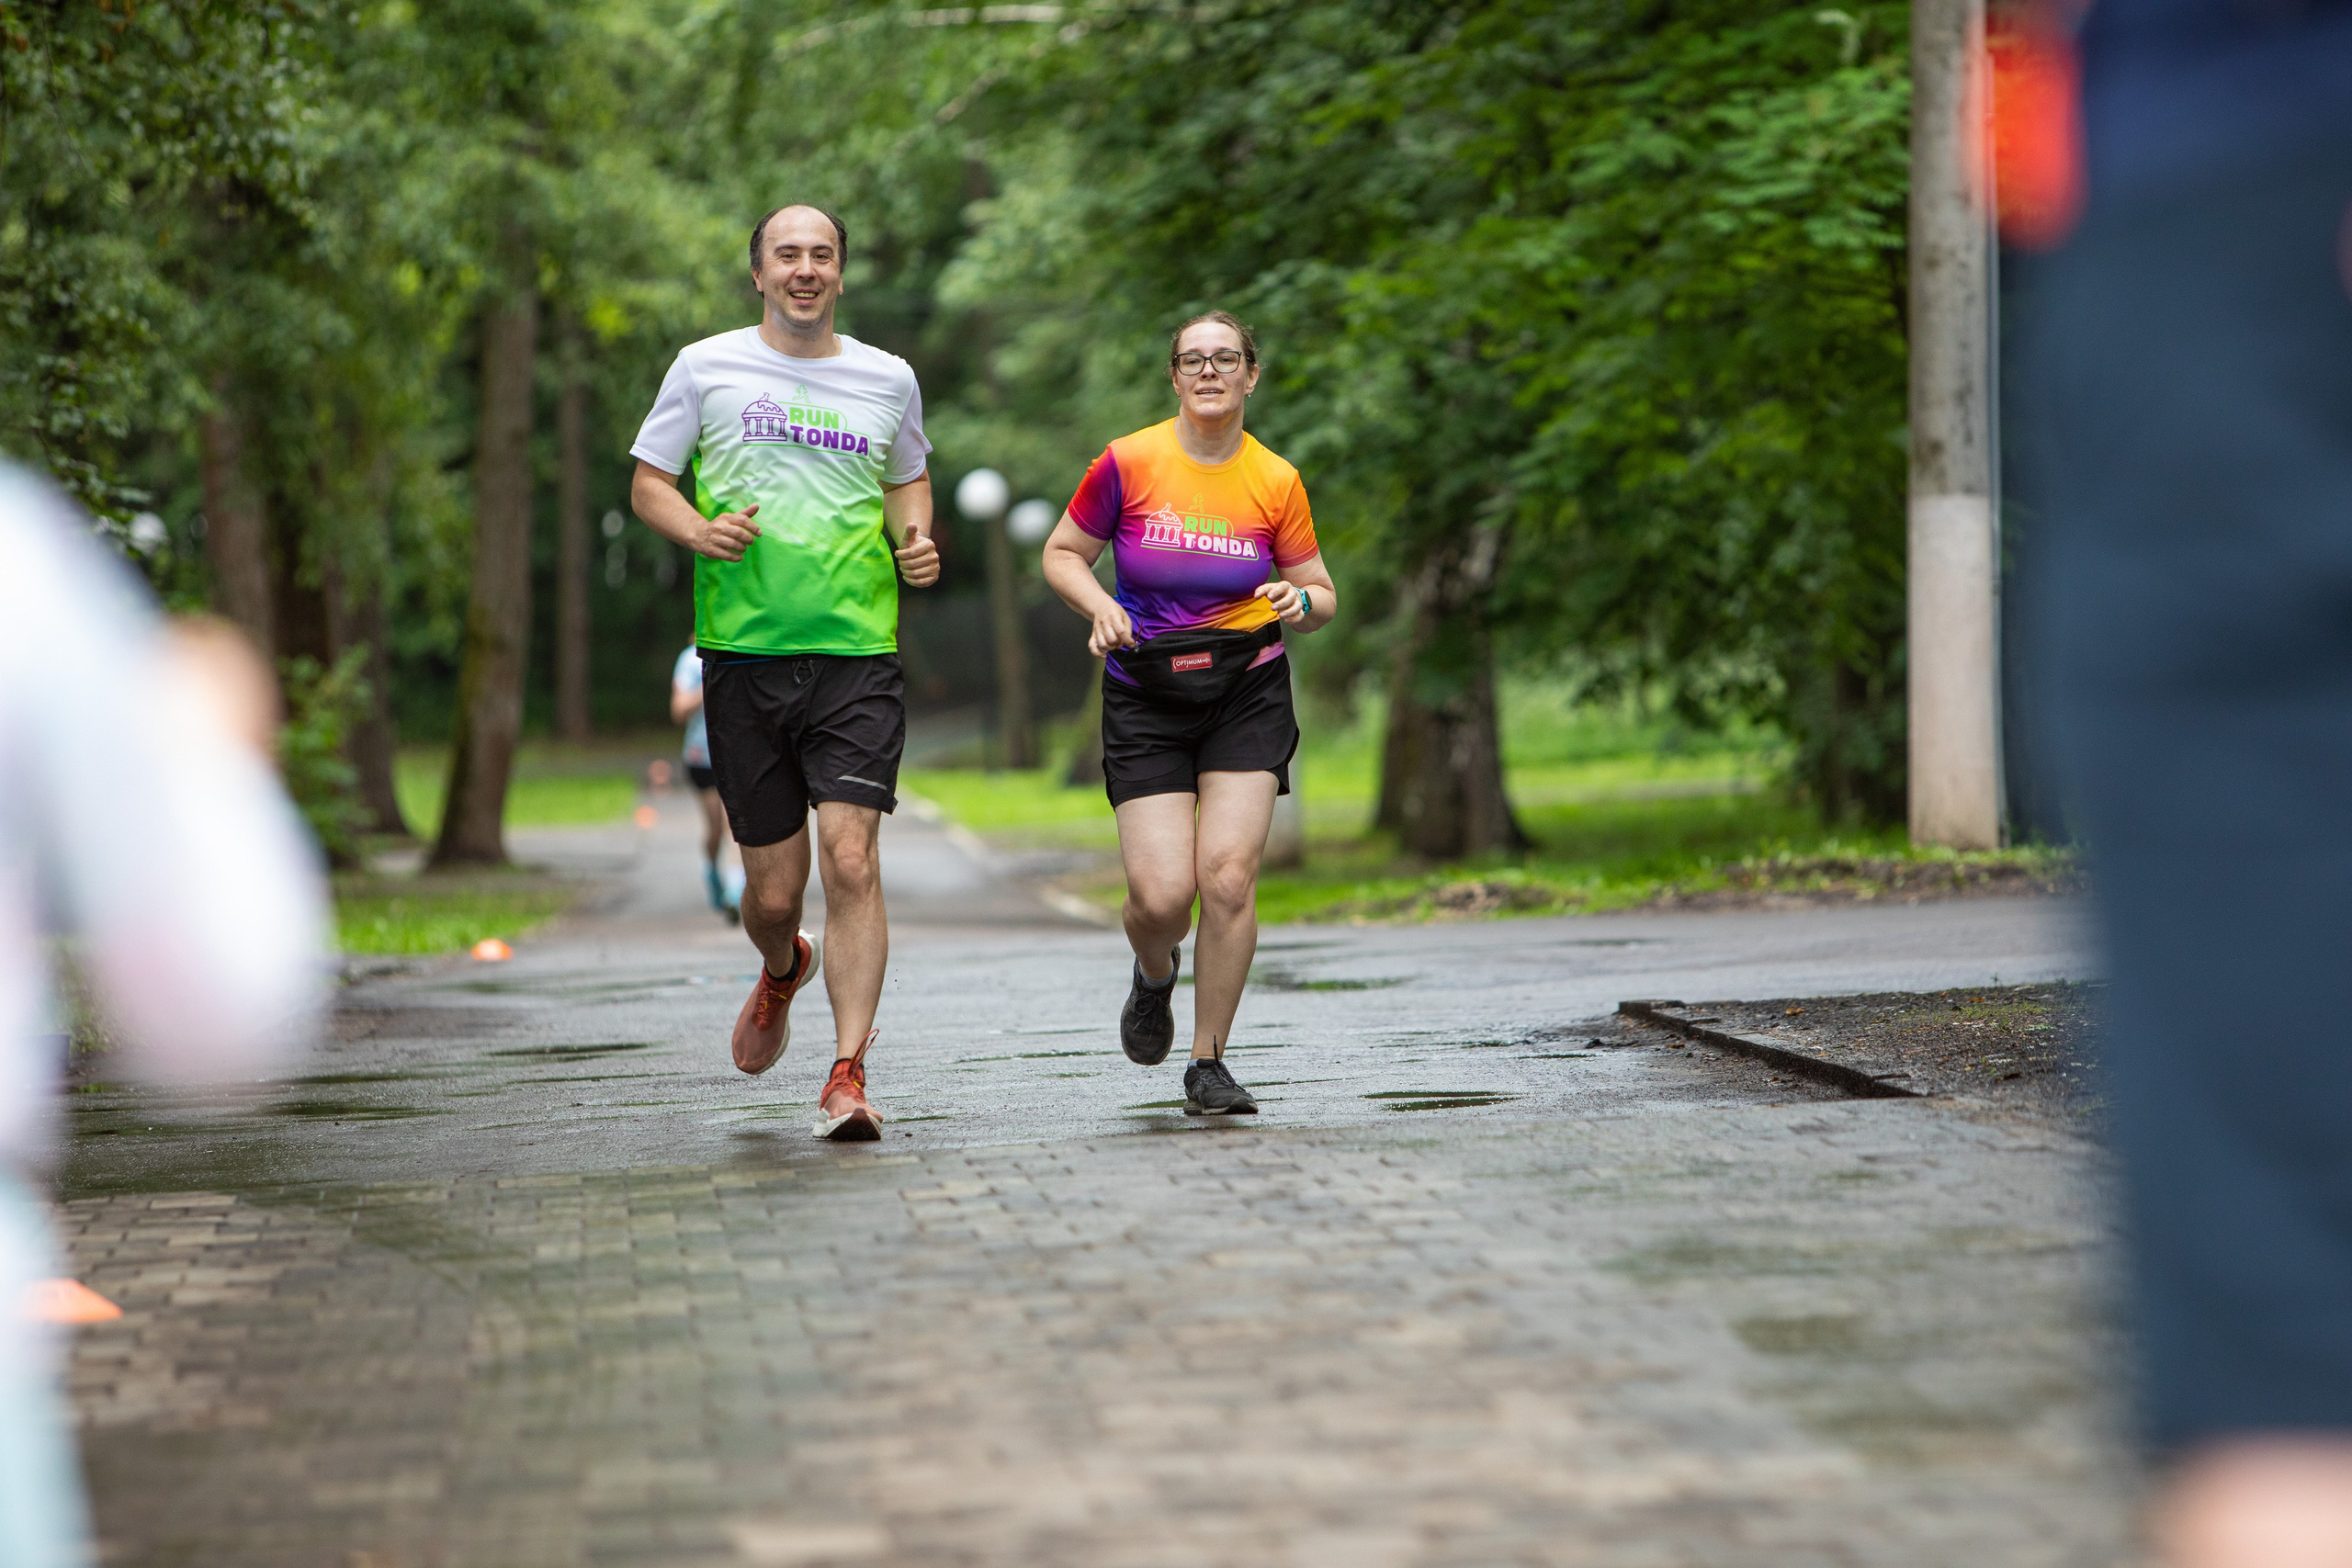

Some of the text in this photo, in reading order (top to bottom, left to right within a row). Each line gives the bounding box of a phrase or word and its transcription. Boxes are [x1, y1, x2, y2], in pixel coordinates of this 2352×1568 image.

[790, 407, 840, 429] RUN
[790, 425, 868, 456] TONDA
[1184, 516, 1227, 536] RUN
[1183, 534, 1256, 557] TONDA
